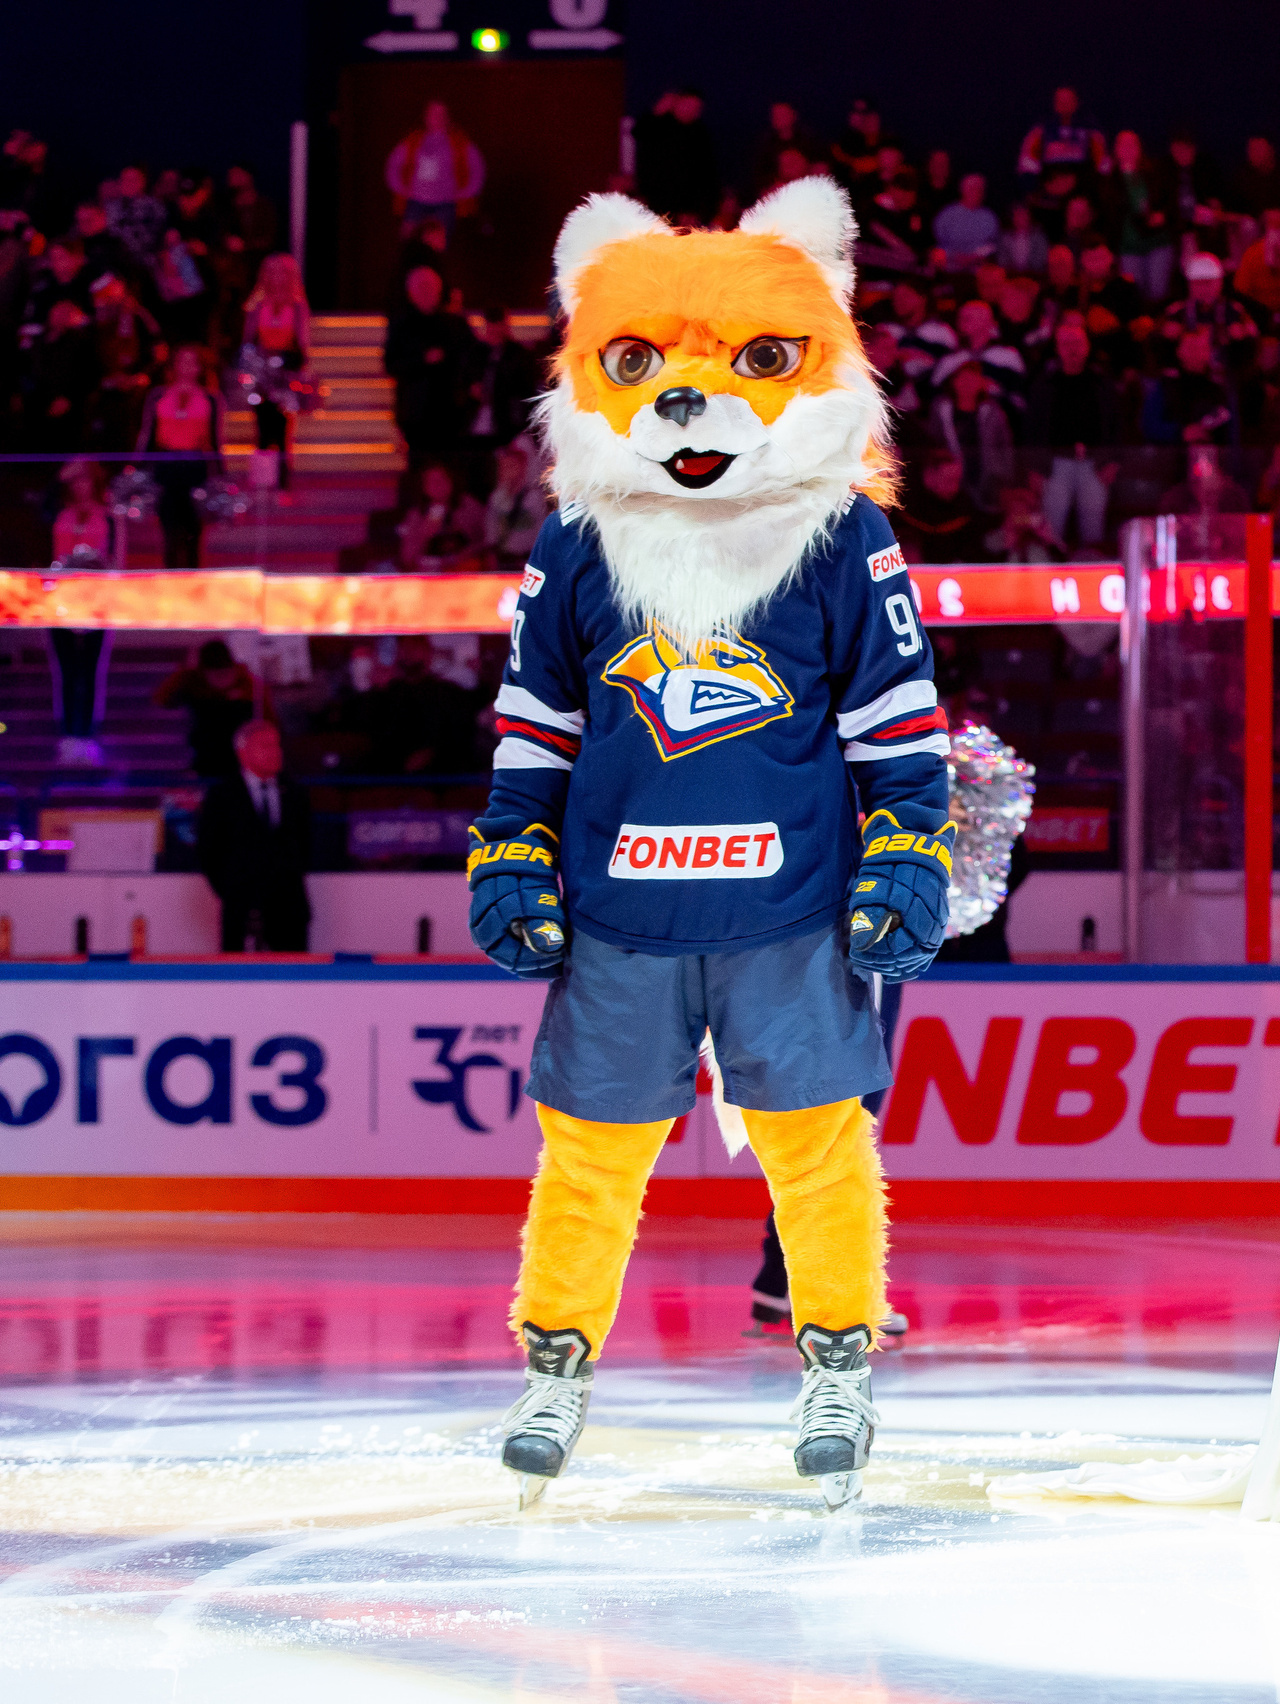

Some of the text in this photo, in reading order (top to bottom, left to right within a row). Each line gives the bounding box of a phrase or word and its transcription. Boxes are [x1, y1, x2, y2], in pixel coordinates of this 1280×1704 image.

[466, 842, 554, 882] AUER
[611, 832, 776, 869] FONBET
[863, 833, 953, 878] BAUE
[0, 1032, 329, 1127] огаз
